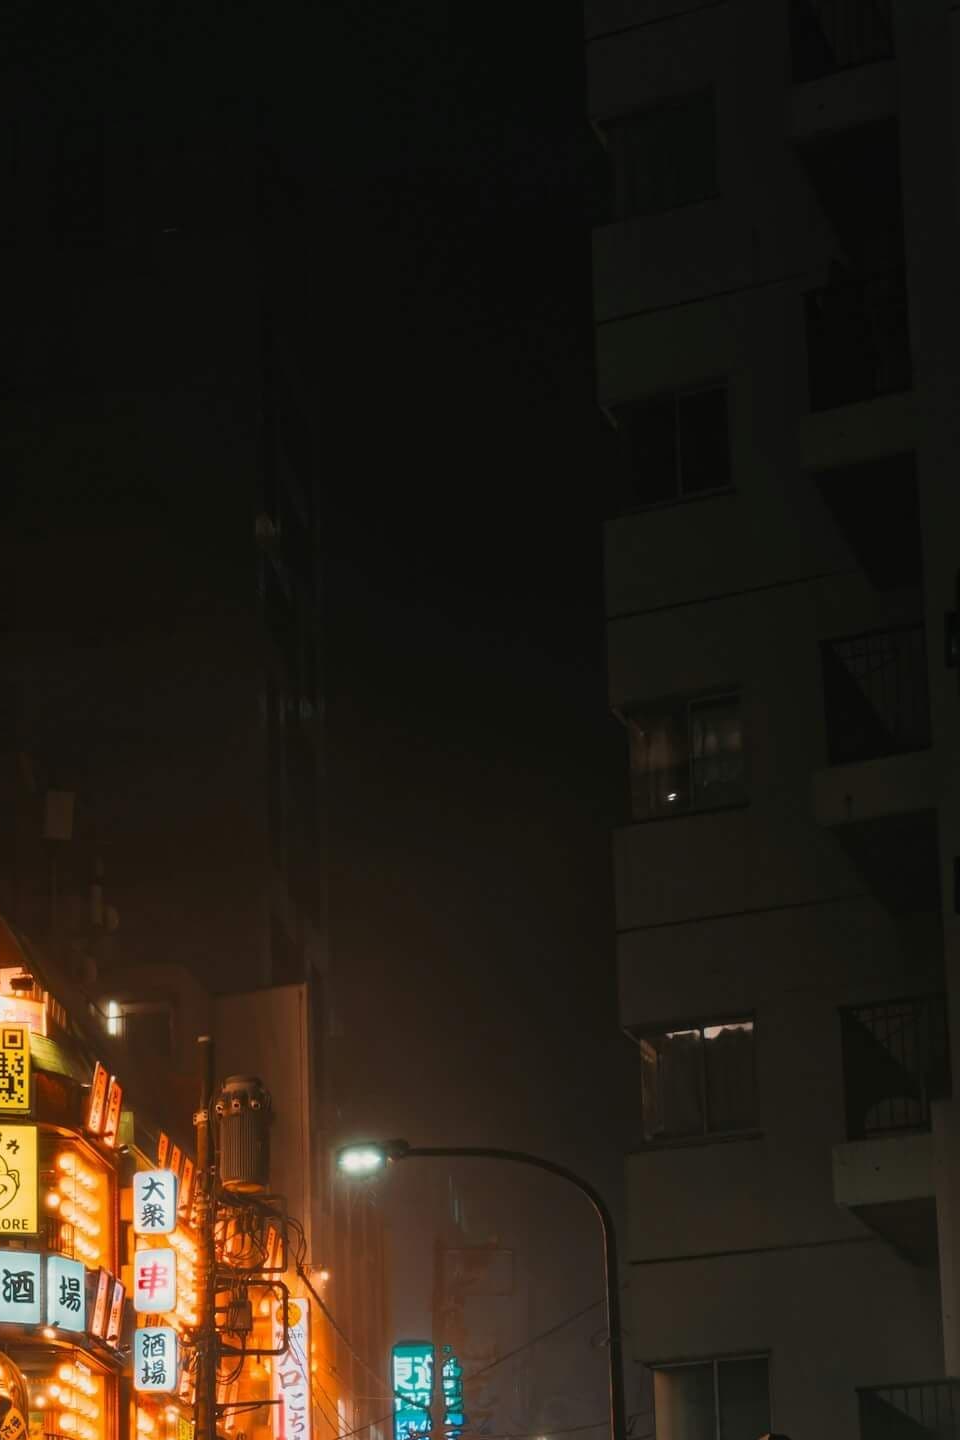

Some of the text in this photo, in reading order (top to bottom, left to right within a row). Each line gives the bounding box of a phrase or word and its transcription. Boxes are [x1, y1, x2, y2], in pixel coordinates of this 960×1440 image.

[142, 1177, 167, 1228] 大衆
[138, 1262, 168, 1299] 串
[141, 1333, 167, 1385] 酒場
